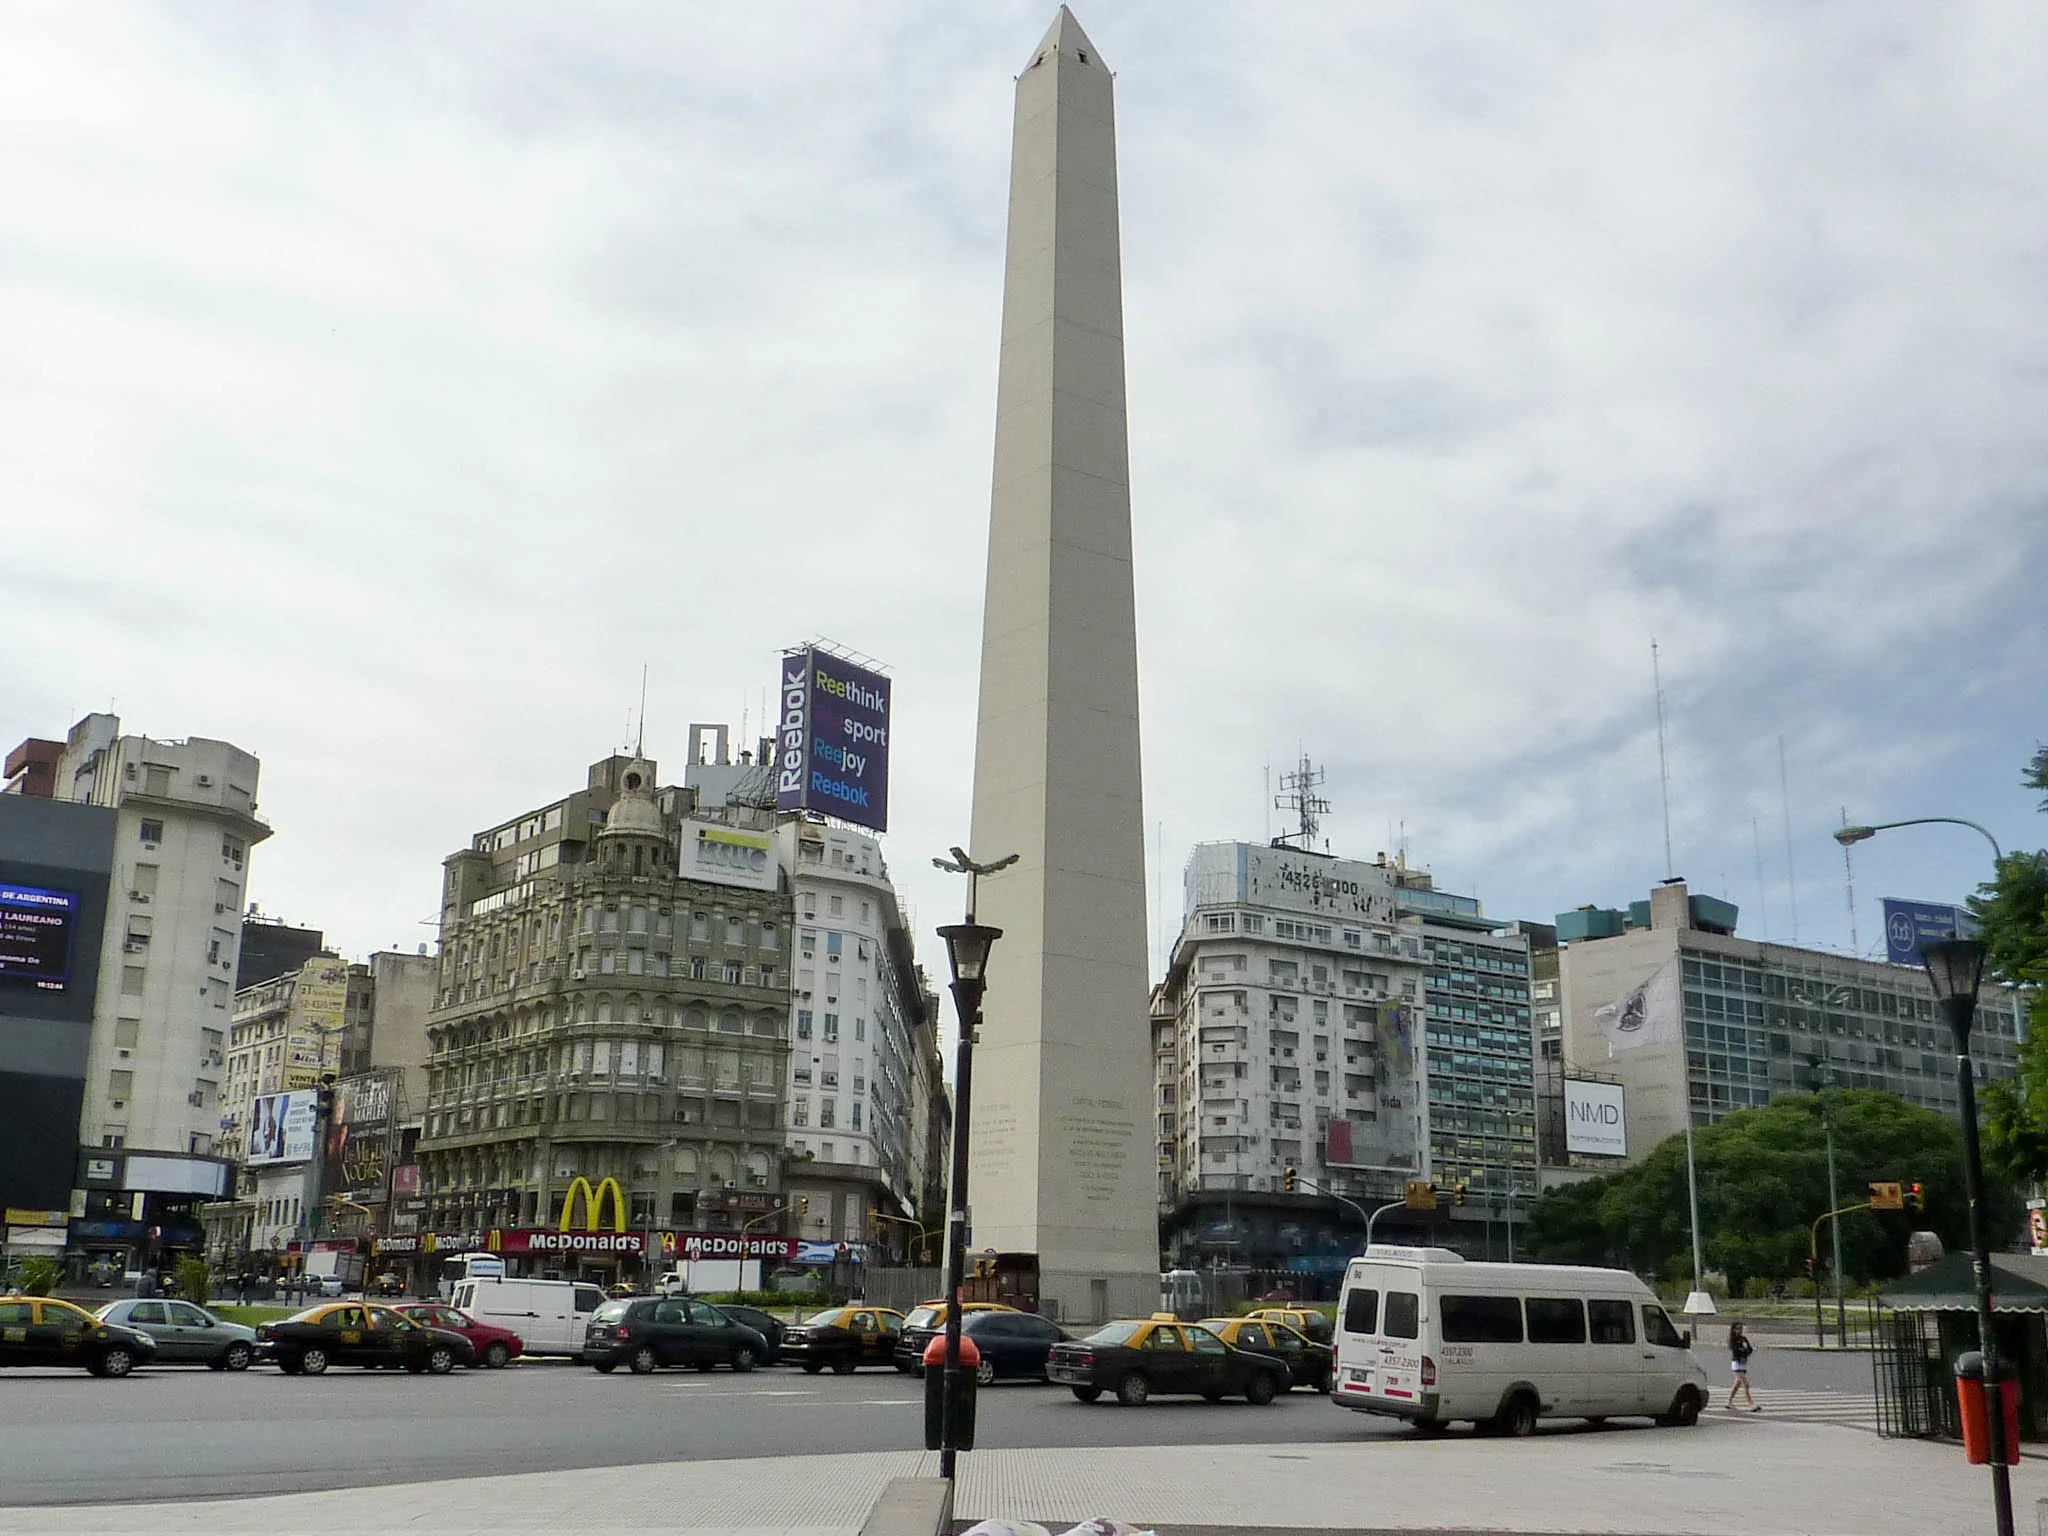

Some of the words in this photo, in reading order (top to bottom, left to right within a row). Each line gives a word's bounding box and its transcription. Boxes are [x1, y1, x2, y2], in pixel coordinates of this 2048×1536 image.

[815, 669, 886, 714] Reethink
[780, 668, 807, 795] Reebok
[843, 717, 887, 747] sport
[813, 737, 867, 779] Reejoy
[811, 771, 869, 808] Reebok
[2, 891, 16, 899] DE
[17, 893, 69, 907] ARGENTINA
[4, 912, 63, 926] LAUREANO
[353, 1104, 389, 1122] MAHLER
[1570, 1100, 1619, 1125] NMD
[528, 1234, 641, 1251] McDonald's
